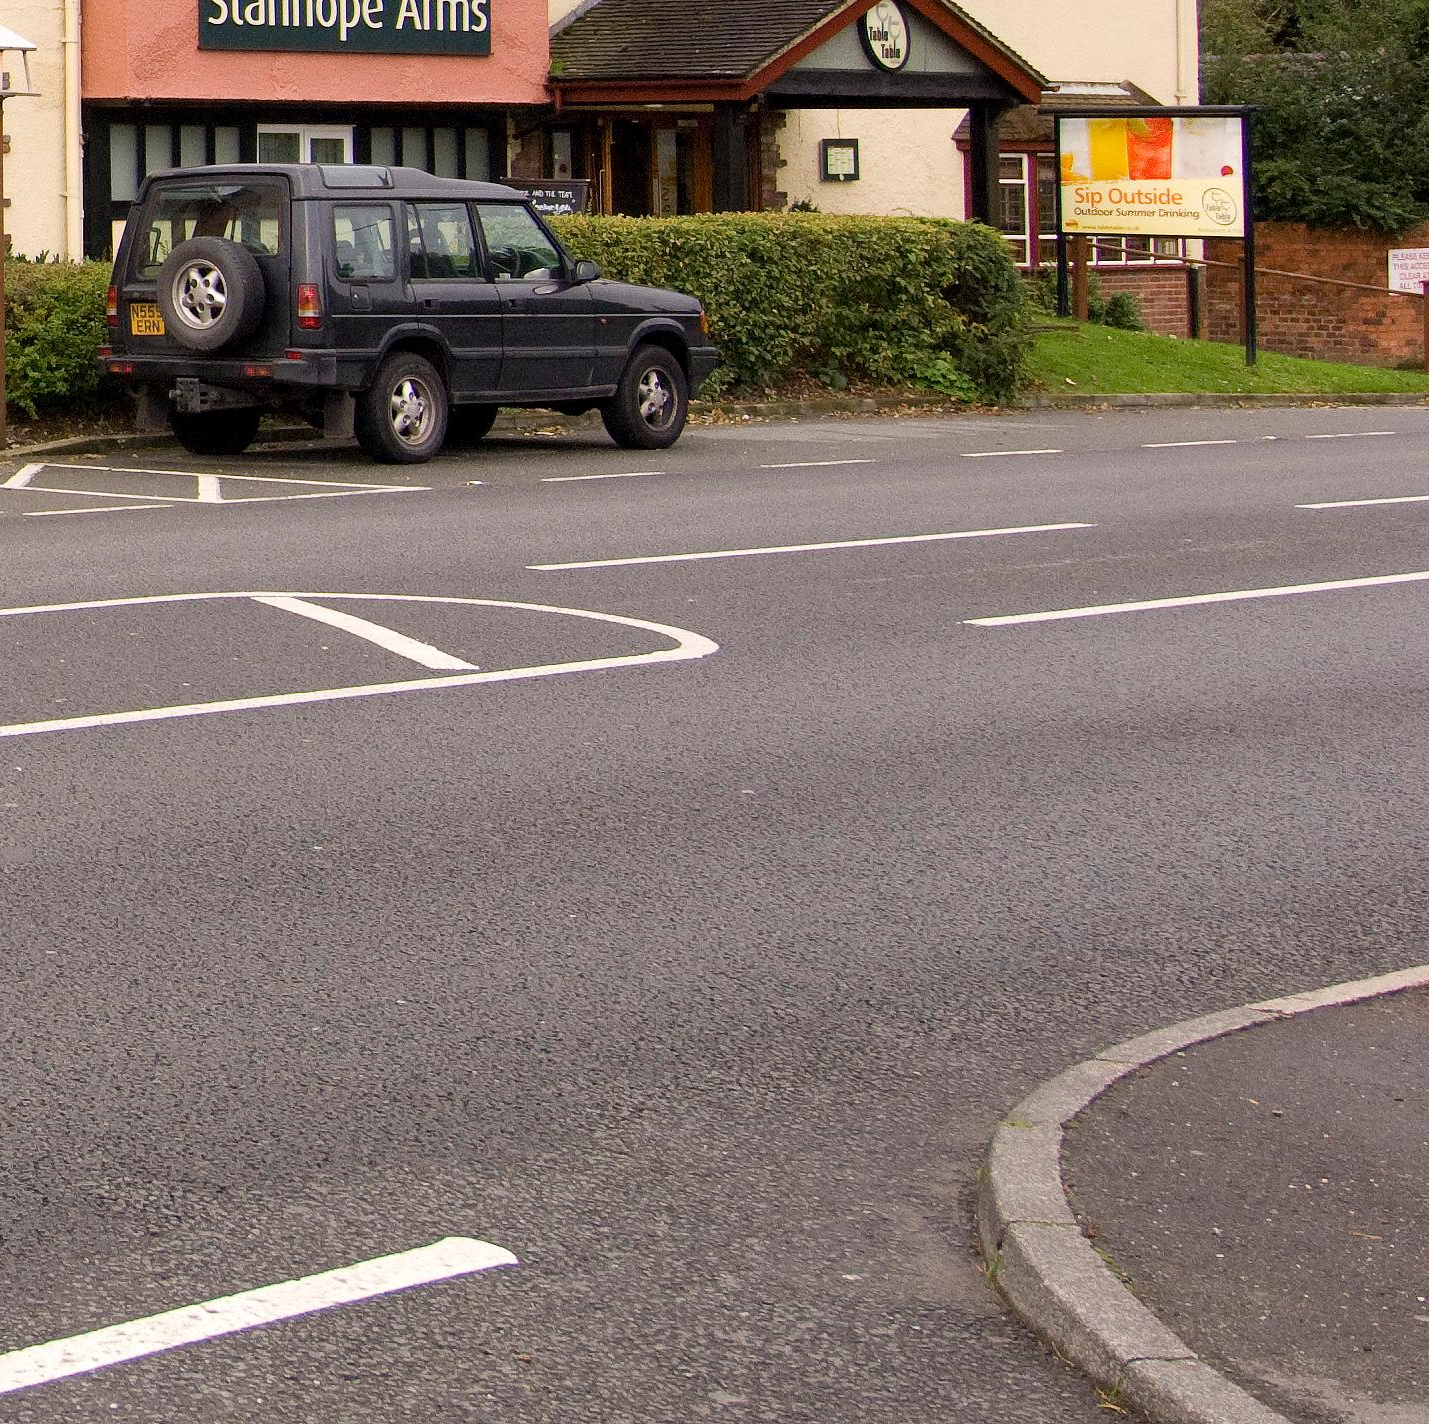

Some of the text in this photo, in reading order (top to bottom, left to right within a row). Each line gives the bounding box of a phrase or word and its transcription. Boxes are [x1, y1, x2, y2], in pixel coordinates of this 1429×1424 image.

[869, 26, 889, 41] Table
[881, 43, 901, 59] Table
[1074, 187, 1183, 208] Sip Outside
[1073, 206, 1200, 220] Outdoor Summer Drinking
[136, 319, 160, 333] ERN
